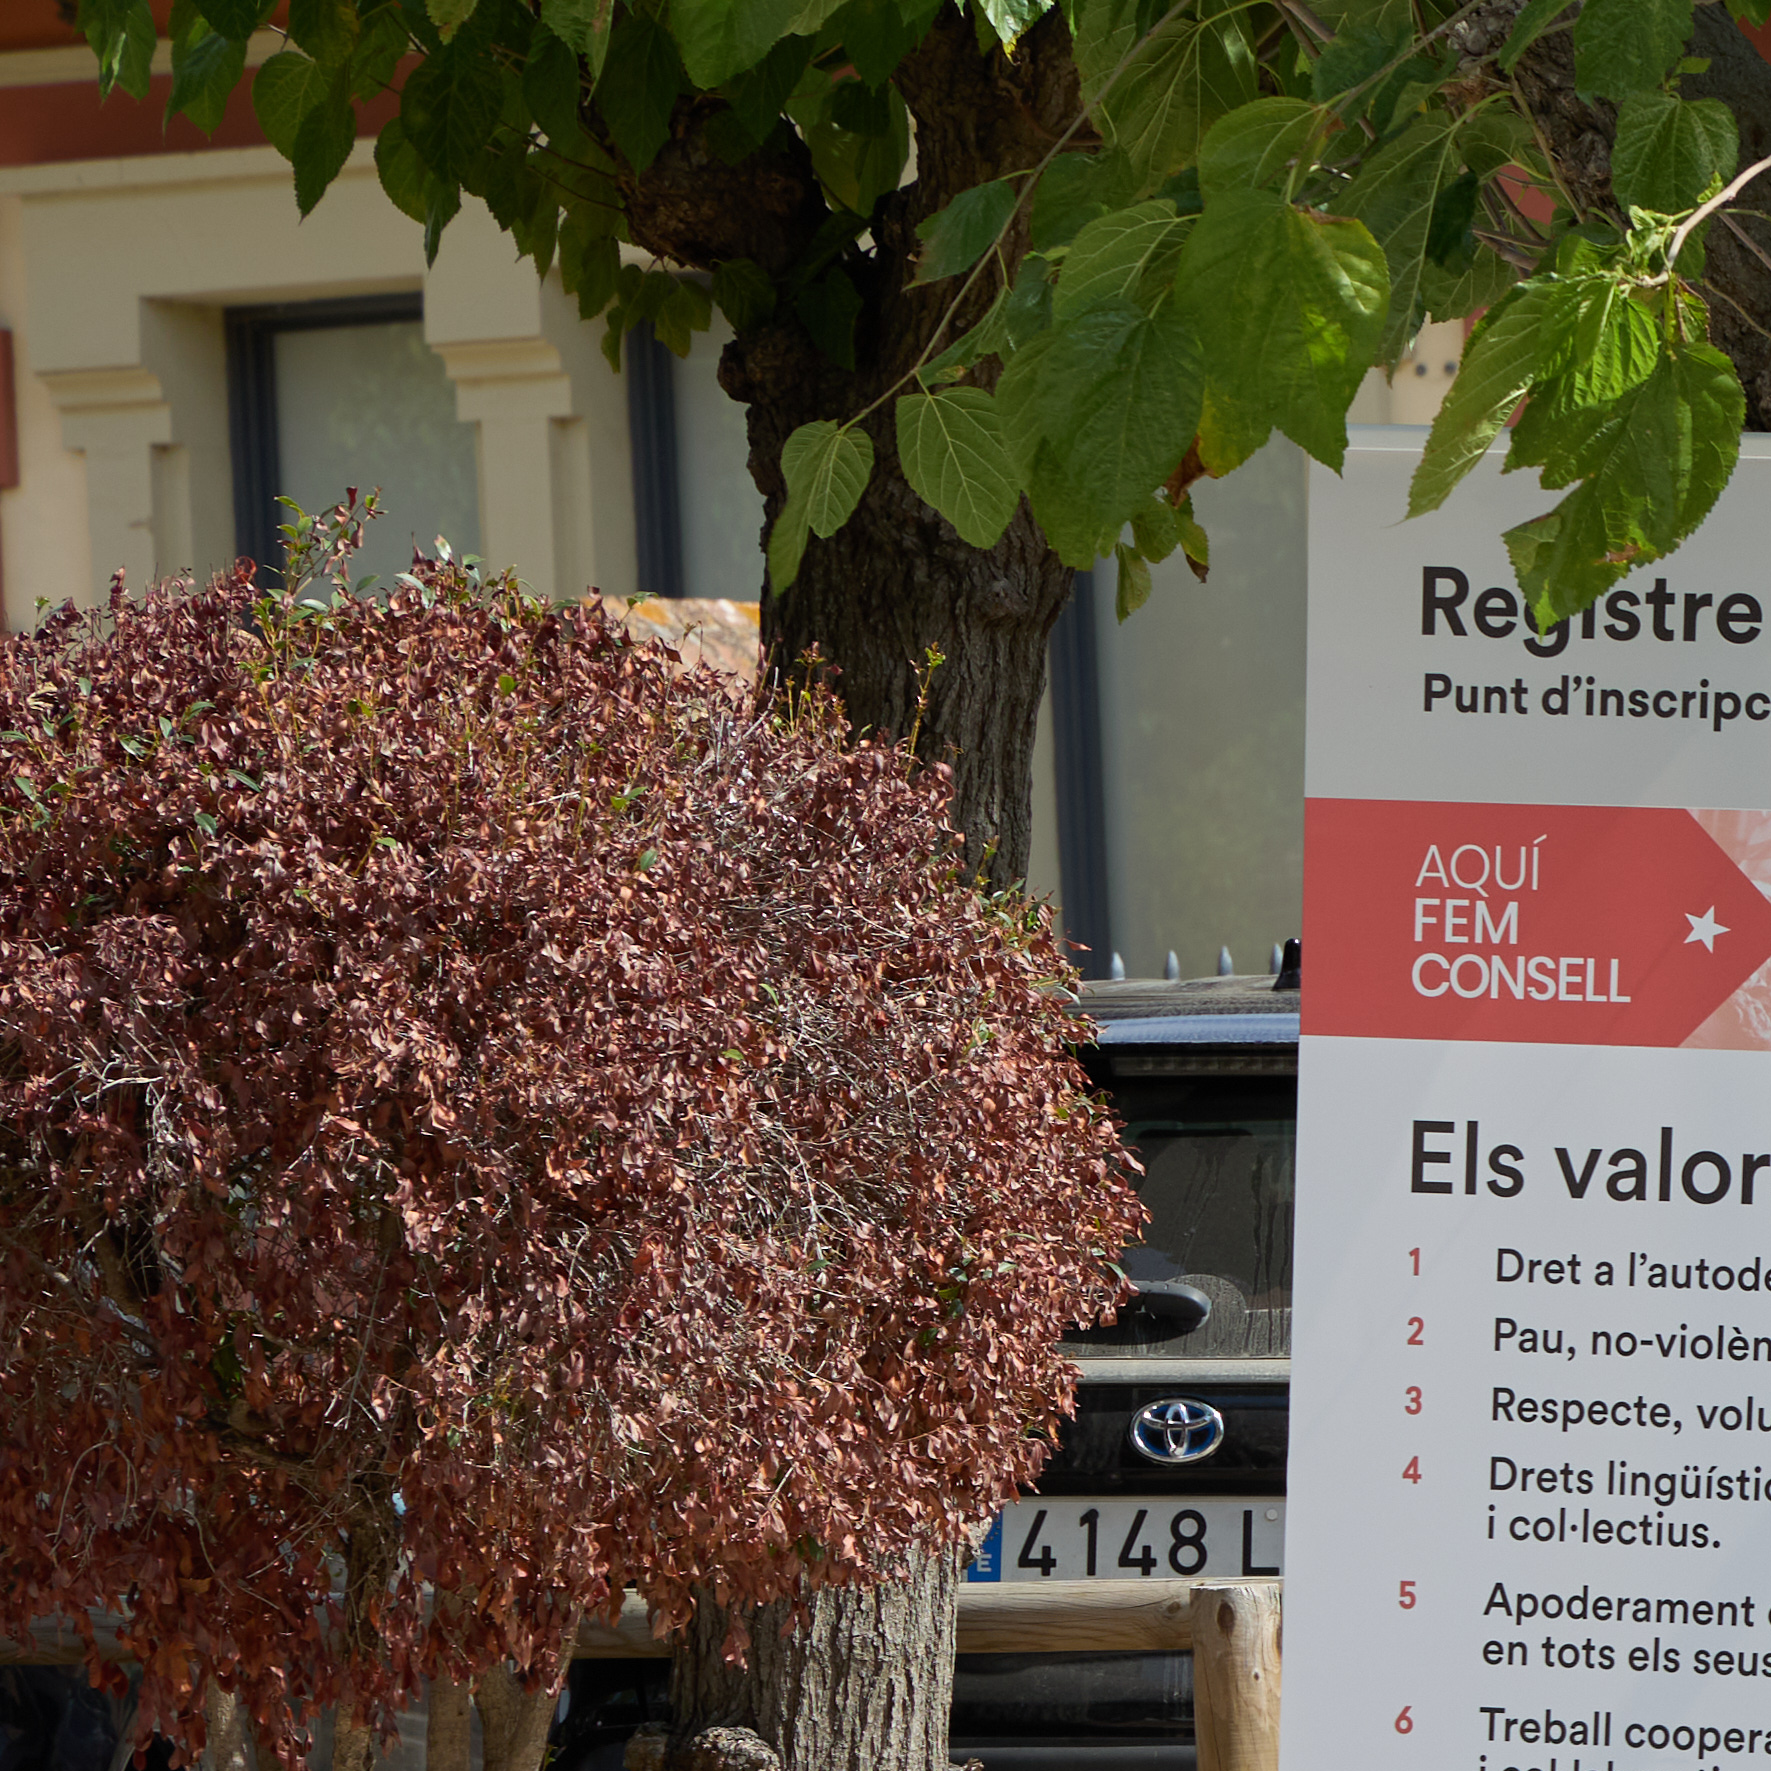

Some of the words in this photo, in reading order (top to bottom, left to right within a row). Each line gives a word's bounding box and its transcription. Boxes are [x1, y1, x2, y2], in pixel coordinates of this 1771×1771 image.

[1423, 672, 1529, 715] Punt
[1414, 833, 1548, 898] AQUÍ
[1413, 897, 1519, 945] FEM
[1410, 952, 1632, 1004] CONSELL
[1410, 1119, 1525, 1198] Els
[1409, 1247, 1420, 1276] 1
[1496, 1248, 1582, 1285] Dret
[1594, 1261, 1614, 1287] a
[1407, 1317, 1424, 1346] 2
[1494, 1317, 1576, 1362] Pau,
[1405, 1386, 1422, 1415] 3
[1492, 1386, 1682, 1436] Respecte,
[1402, 1456, 1422, 1484] 4
[1489, 1456, 1594, 1495] Drets
[1016, 1508, 1209, 1578] 4148
[1242, 1509, 1281, 1577] L
[1487, 1504, 1495, 1540] i
[1509, 1507, 1721, 1549] col·lectius.
[1399, 1580, 1416, 1610] 5
[1483, 1582, 1755, 1628] Apoderament
[1482, 1640, 1528, 1666] en
[1541, 1636, 1615, 1670] tots
[1628, 1636, 1681, 1674] els
[1395, 1706, 1413, 1734] 6
[1479, 1706, 1611, 1747] Treball
